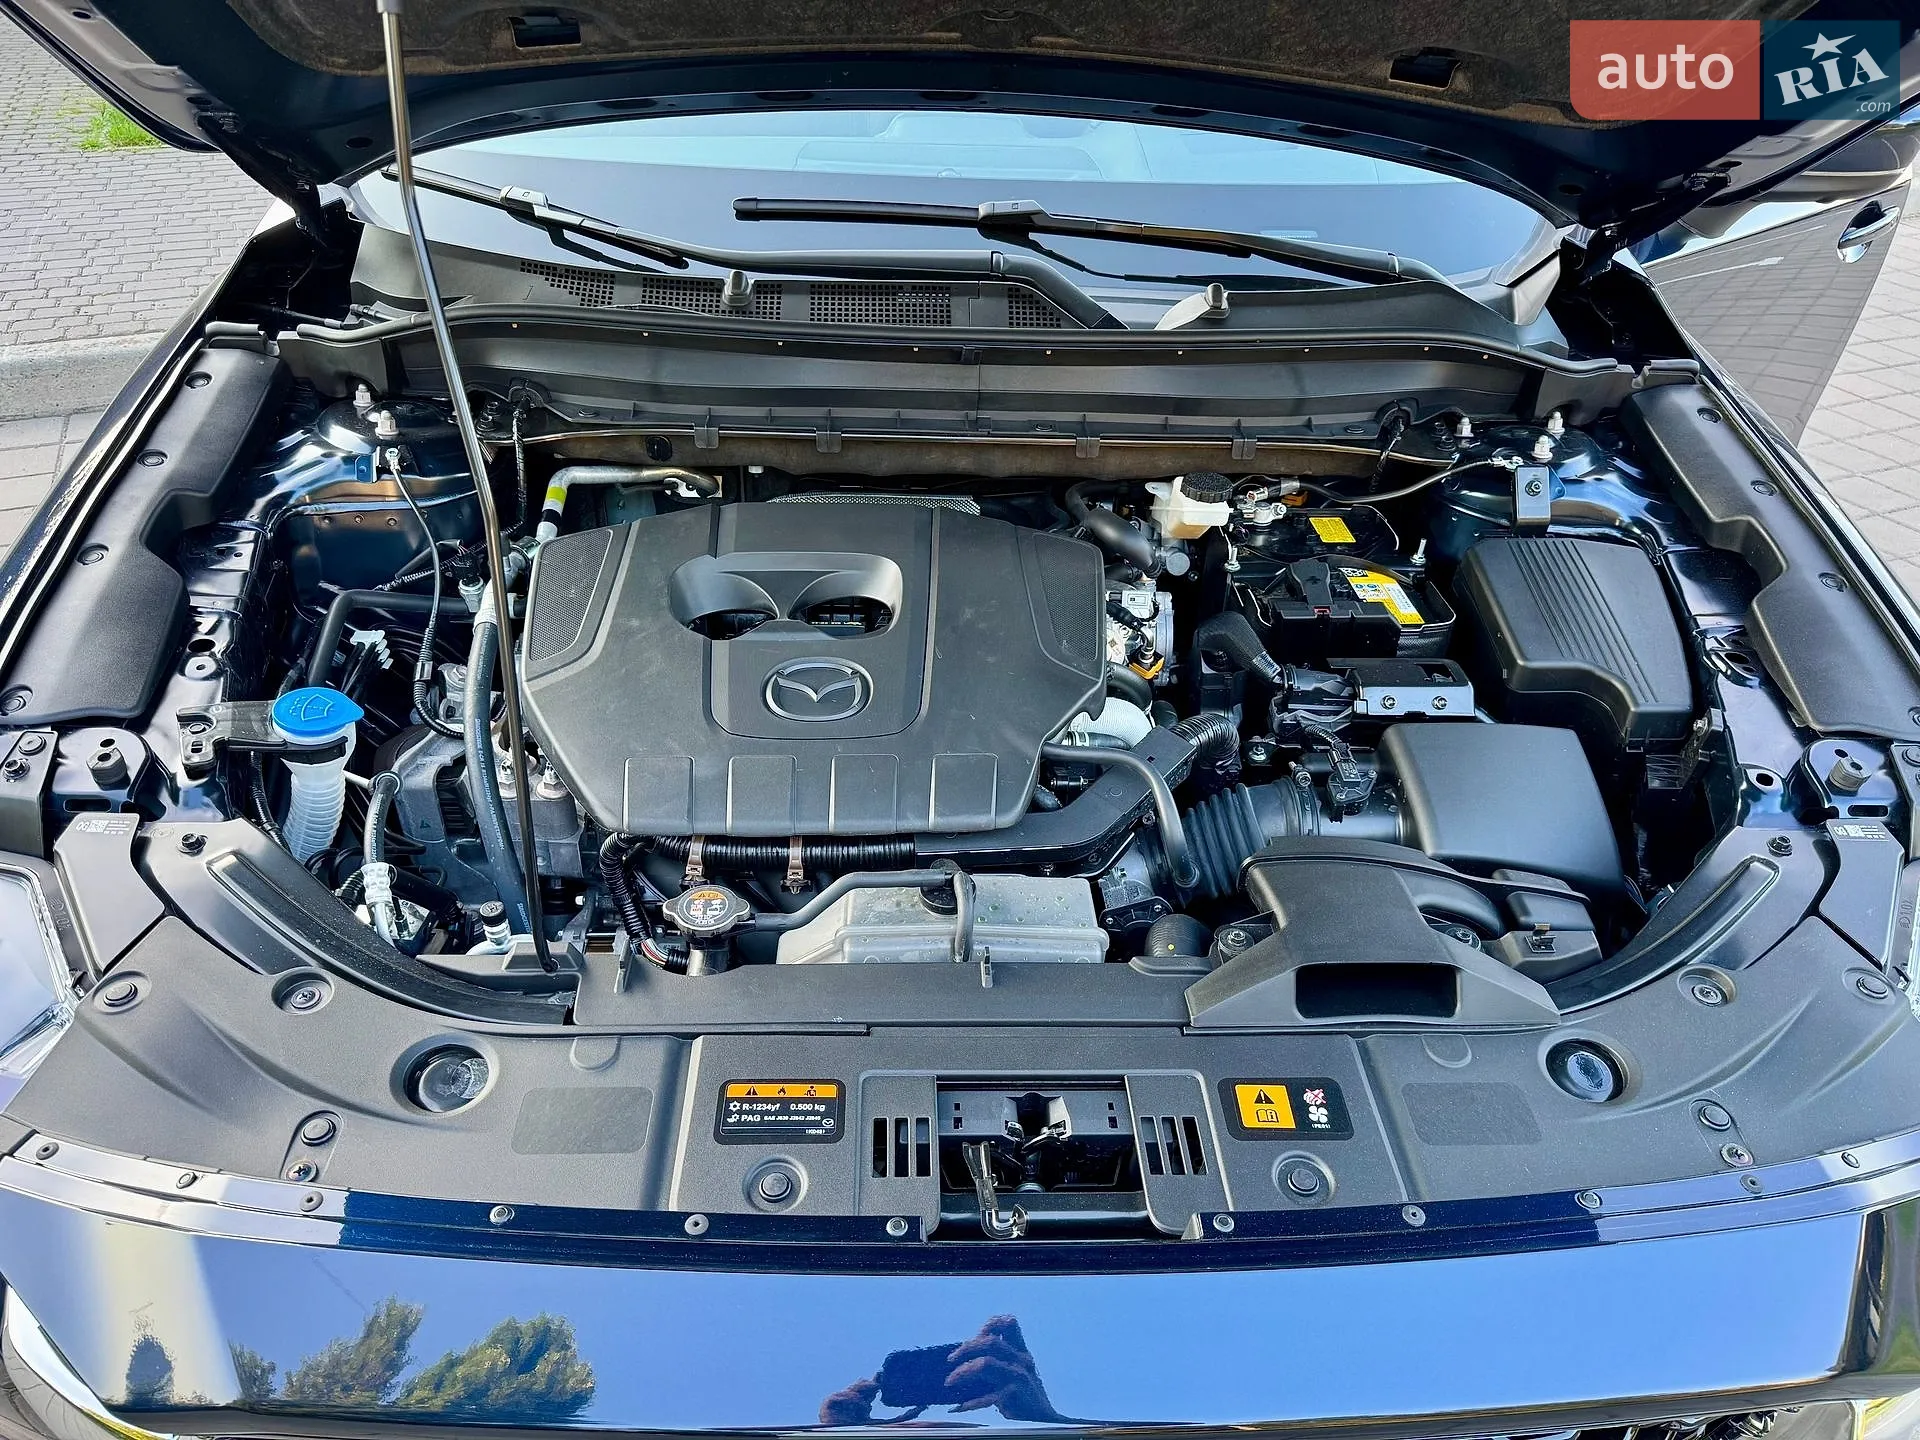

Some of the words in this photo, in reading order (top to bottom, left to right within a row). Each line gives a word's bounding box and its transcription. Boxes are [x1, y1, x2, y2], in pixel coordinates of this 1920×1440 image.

[742, 1103, 780, 1112] R-1234yf
[790, 1103, 813, 1111] 0.500
[814, 1103, 826, 1112] kg
[741, 1114, 761, 1122] PAG
